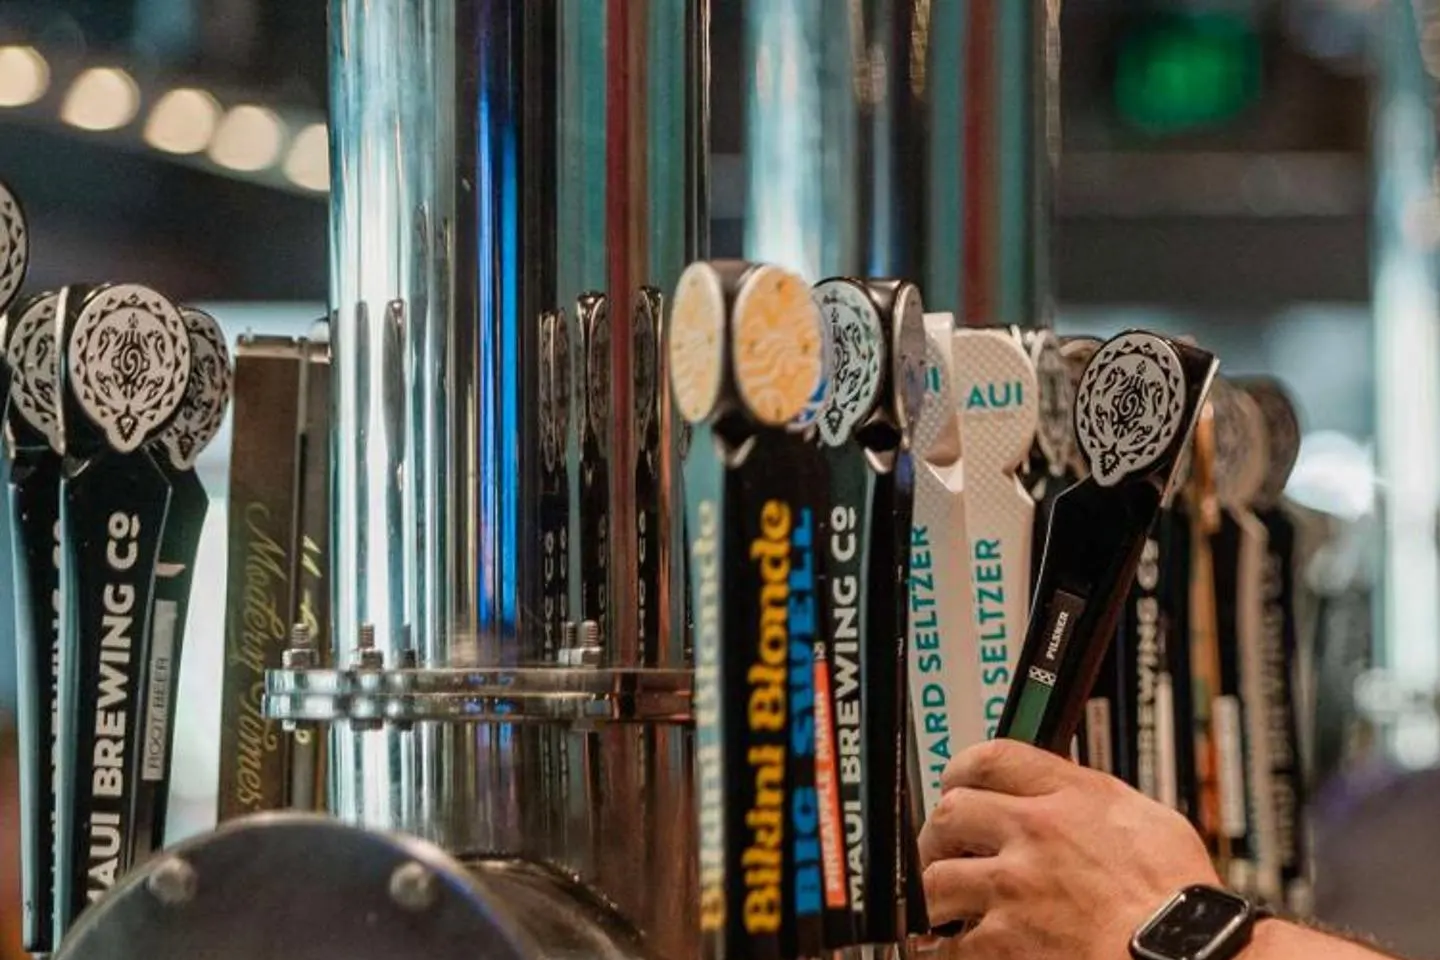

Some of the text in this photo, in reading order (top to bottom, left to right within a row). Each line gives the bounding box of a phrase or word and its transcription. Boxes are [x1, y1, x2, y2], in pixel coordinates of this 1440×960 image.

[966, 381, 1023, 410] AUI
[236, 502, 288, 806] Modern Times
[909, 525, 942, 674] SELTZER
[975, 538, 1009, 686] SELTZER
[1046, 611, 1069, 660] PILSNER
[92, 583, 135, 797] BREWING
[147, 656, 169, 770] ROOT BEER
[742, 500, 792, 933] Bikini Blonde
[789, 507, 821, 914] BIG SWELL
[832, 575, 861, 783] BREWING
[844, 801, 864, 911] MAUI
